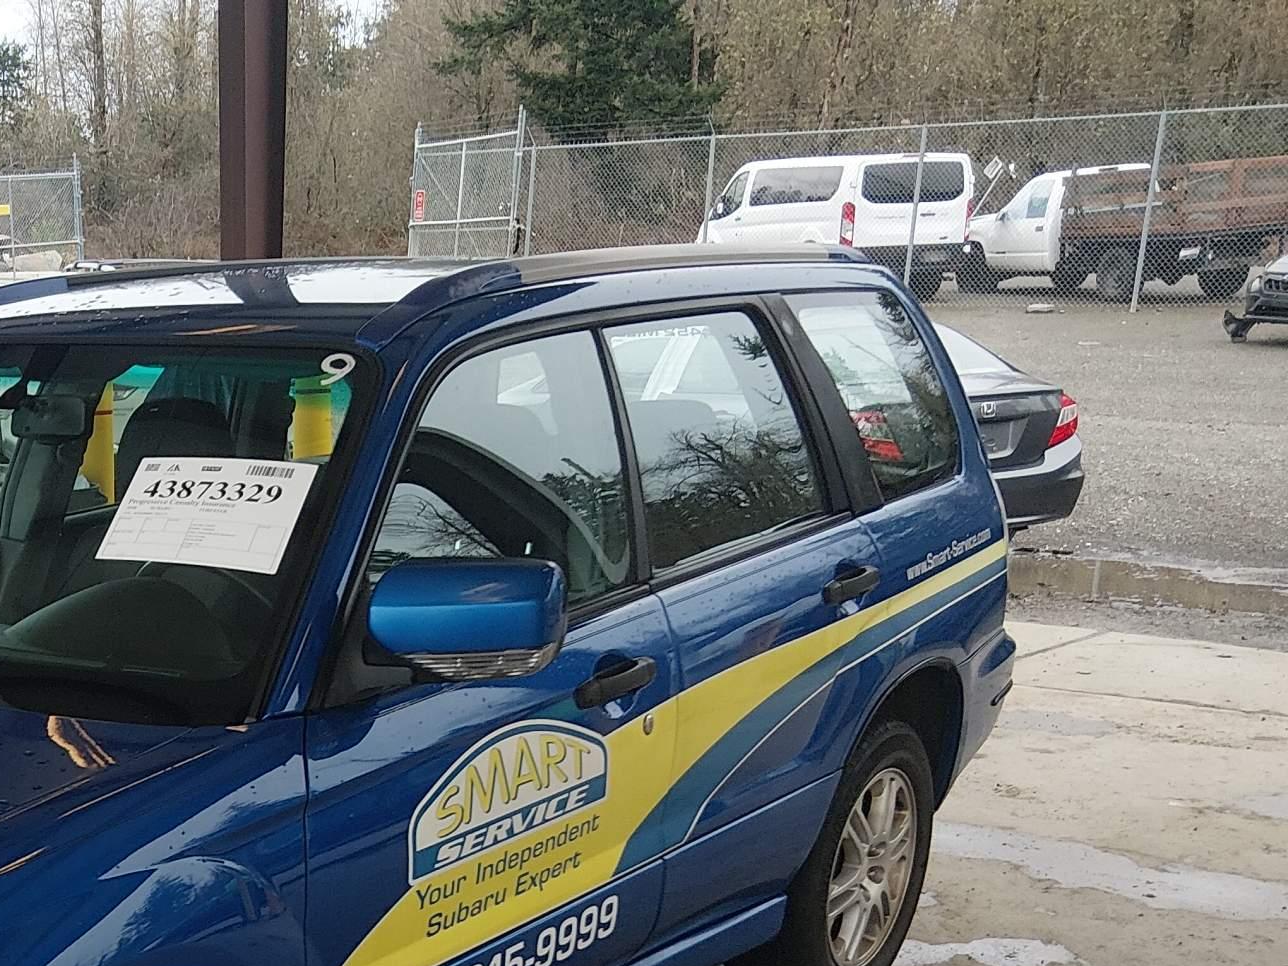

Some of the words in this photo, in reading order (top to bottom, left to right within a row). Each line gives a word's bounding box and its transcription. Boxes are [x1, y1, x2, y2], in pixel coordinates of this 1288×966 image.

[320, 353, 356, 386] 9
[143, 479, 283, 504] 43873329
[432, 783, 591, 870] SERVICE
[435, 735, 591, 840] SMART
[415, 868, 469, 911] Your
[474, 813, 601, 886] Independent
[425, 888, 509, 938] Subaru
[513, 849, 582, 898] Expert
